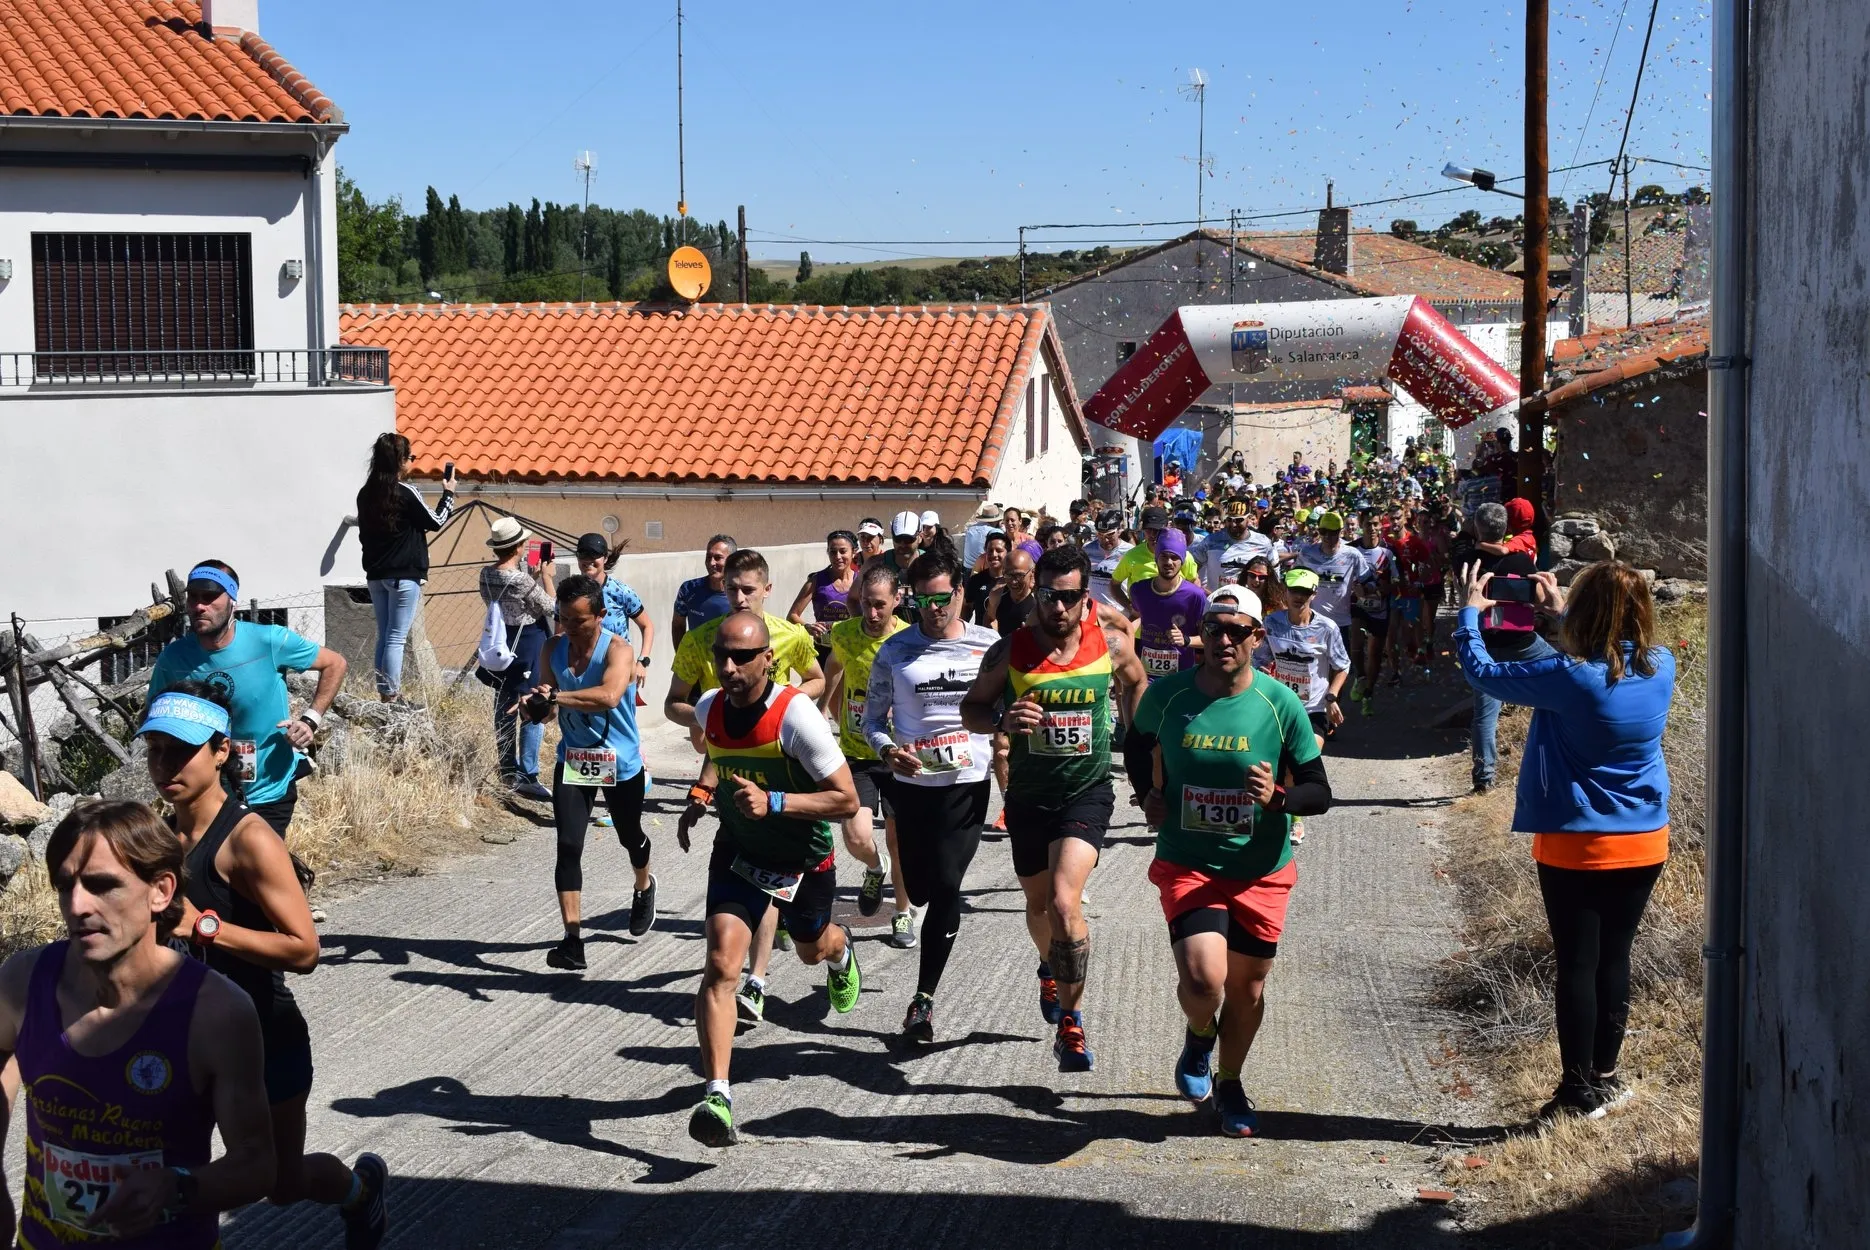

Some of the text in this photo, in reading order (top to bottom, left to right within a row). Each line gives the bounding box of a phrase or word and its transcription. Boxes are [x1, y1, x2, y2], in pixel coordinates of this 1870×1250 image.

[673, 260, 704, 269] Televes
[1270, 324, 1344, 343] Diputación
[1271, 350, 1360, 365] de Salamanca
[1104, 342, 1189, 427] CON EL DEPORTE
[1148, 658, 1171, 670] 128
[1039, 713, 1092, 728] edunia
[1041, 727, 1080, 745] 155
[1181, 733, 1251, 752] BIKILA
[932, 745, 954, 764] 11
[580, 762, 600, 777] 65
[1196, 804, 1240, 825] 130
[100, 1101, 164, 1132] Ruano
[71, 1123, 165, 1149] Macotera
[63, 1179, 111, 1213] 27
